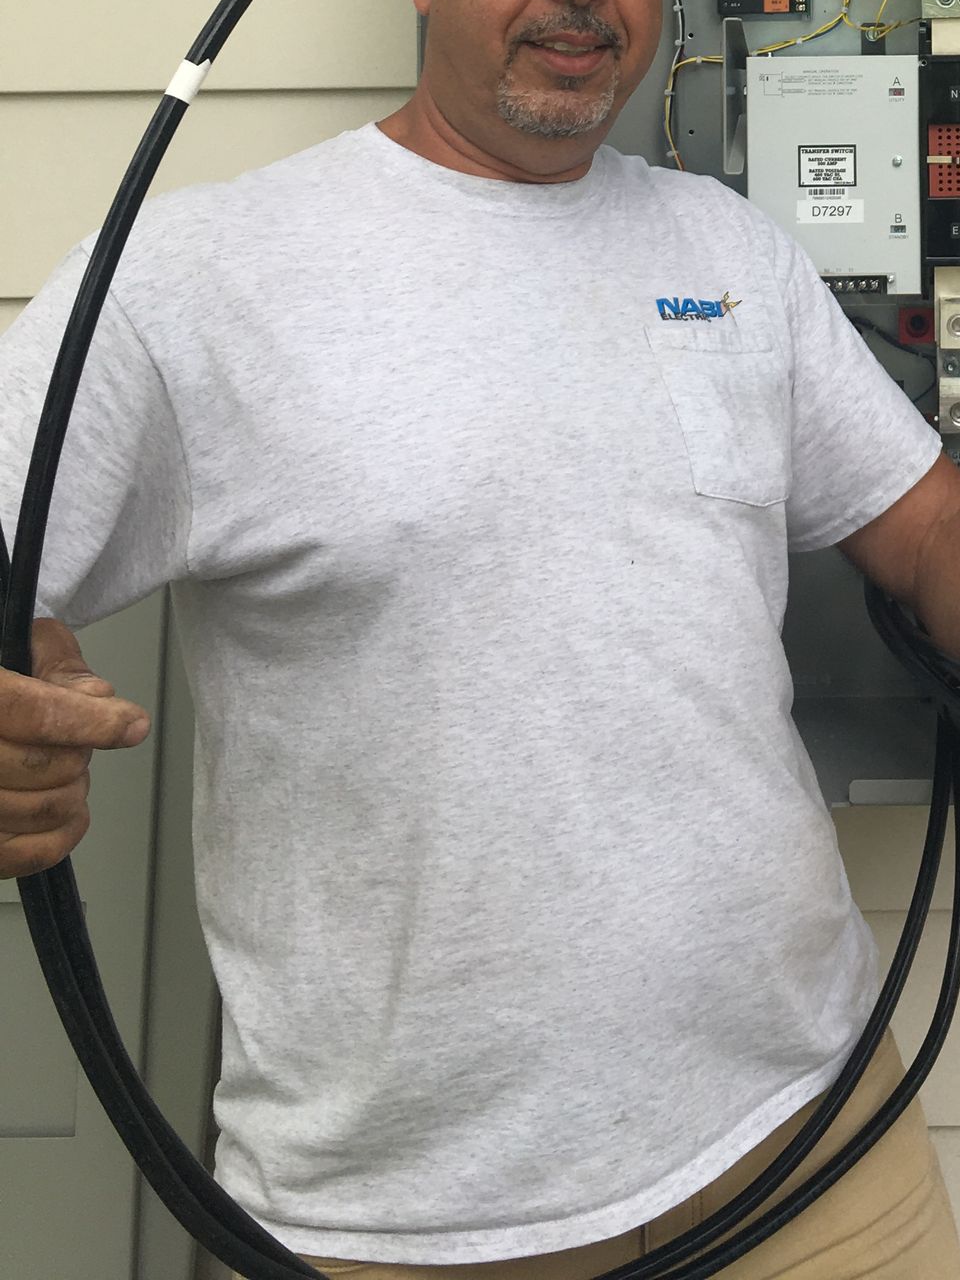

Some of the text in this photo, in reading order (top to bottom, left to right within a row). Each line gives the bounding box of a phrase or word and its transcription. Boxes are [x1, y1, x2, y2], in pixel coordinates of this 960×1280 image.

[892, 76, 901, 86] A
[812, 206, 852, 217] D7297
[894, 213, 903, 223] B
[656, 297, 724, 317] NABI
